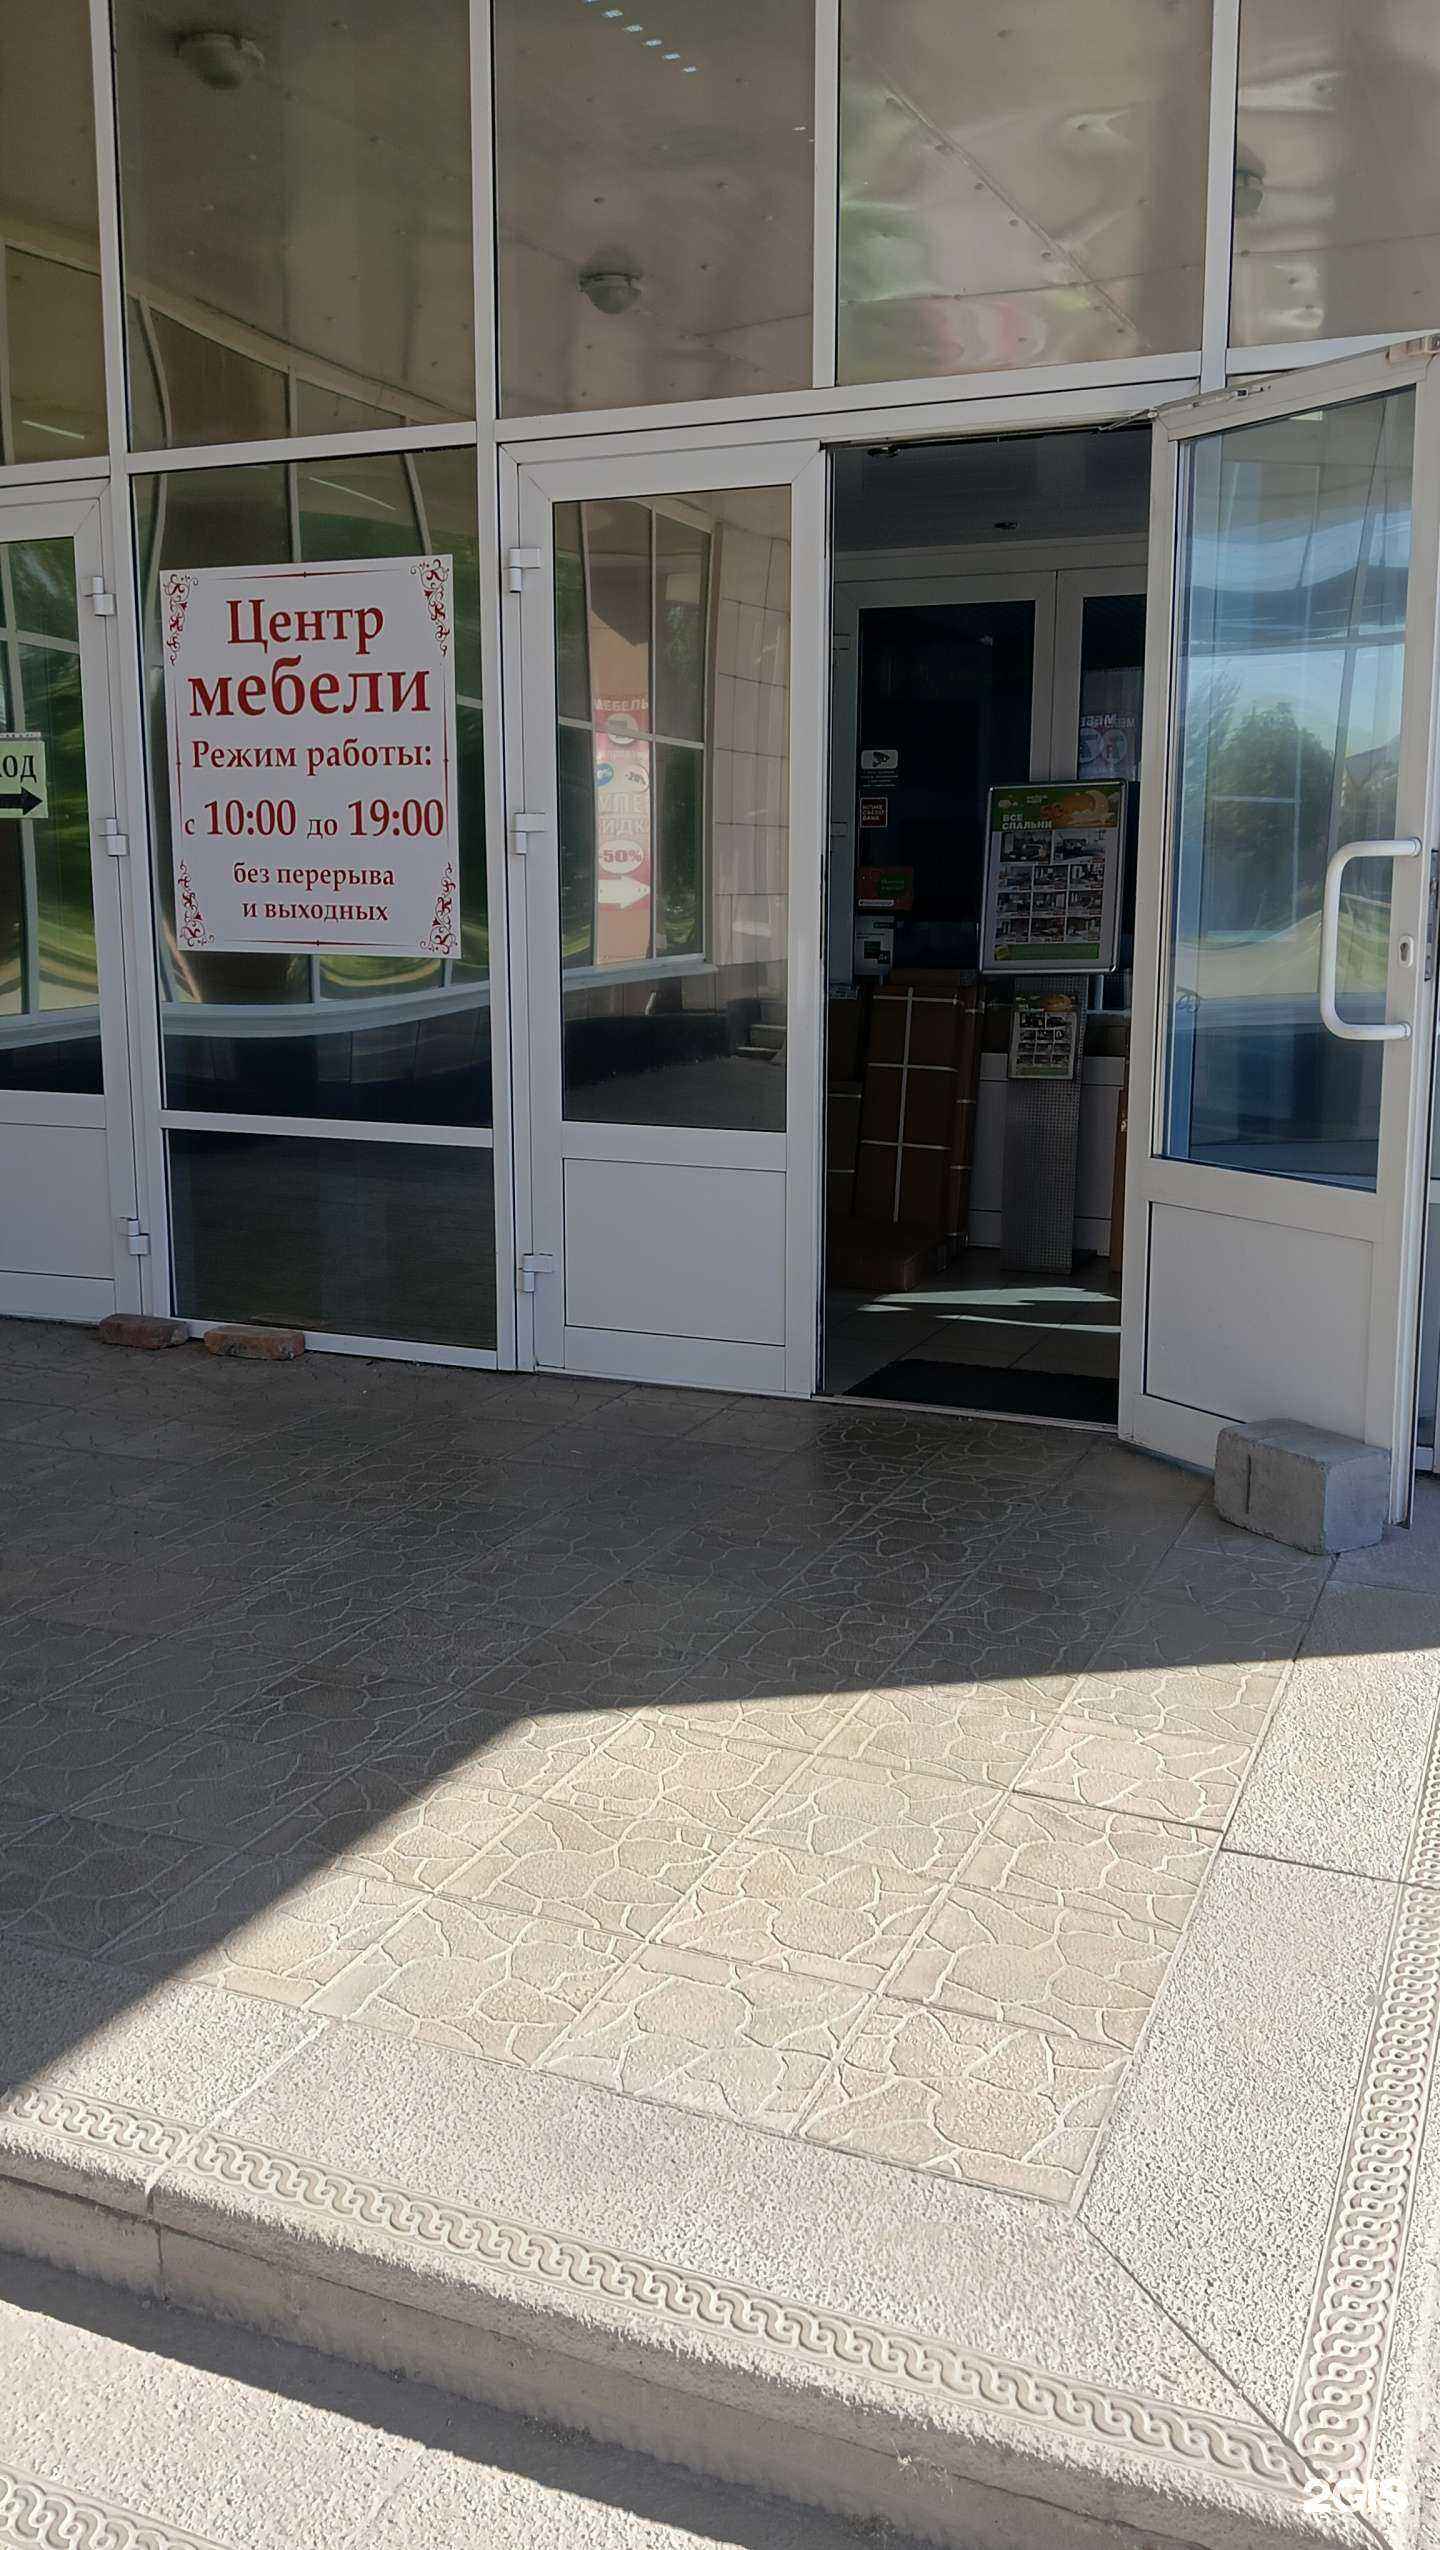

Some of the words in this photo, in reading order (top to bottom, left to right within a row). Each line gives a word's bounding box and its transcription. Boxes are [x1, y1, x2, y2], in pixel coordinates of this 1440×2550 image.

[226, 597, 386, 655] Центр
[187, 655, 431, 717] мебели
[0, 754, 37, 783] ОД
[191, 739, 298, 770] Режим
[306, 738, 432, 777] работы:
[184, 815, 196, 836] с
[204, 798, 297, 837] 10:00
[306, 817, 338, 839] до
[347, 798, 444, 838] 19:00
[233, 862, 270, 885] без
[276, 867, 395, 892] перерыва
[242, 903, 257, 919] и
[264, 903, 389, 923] выходных
